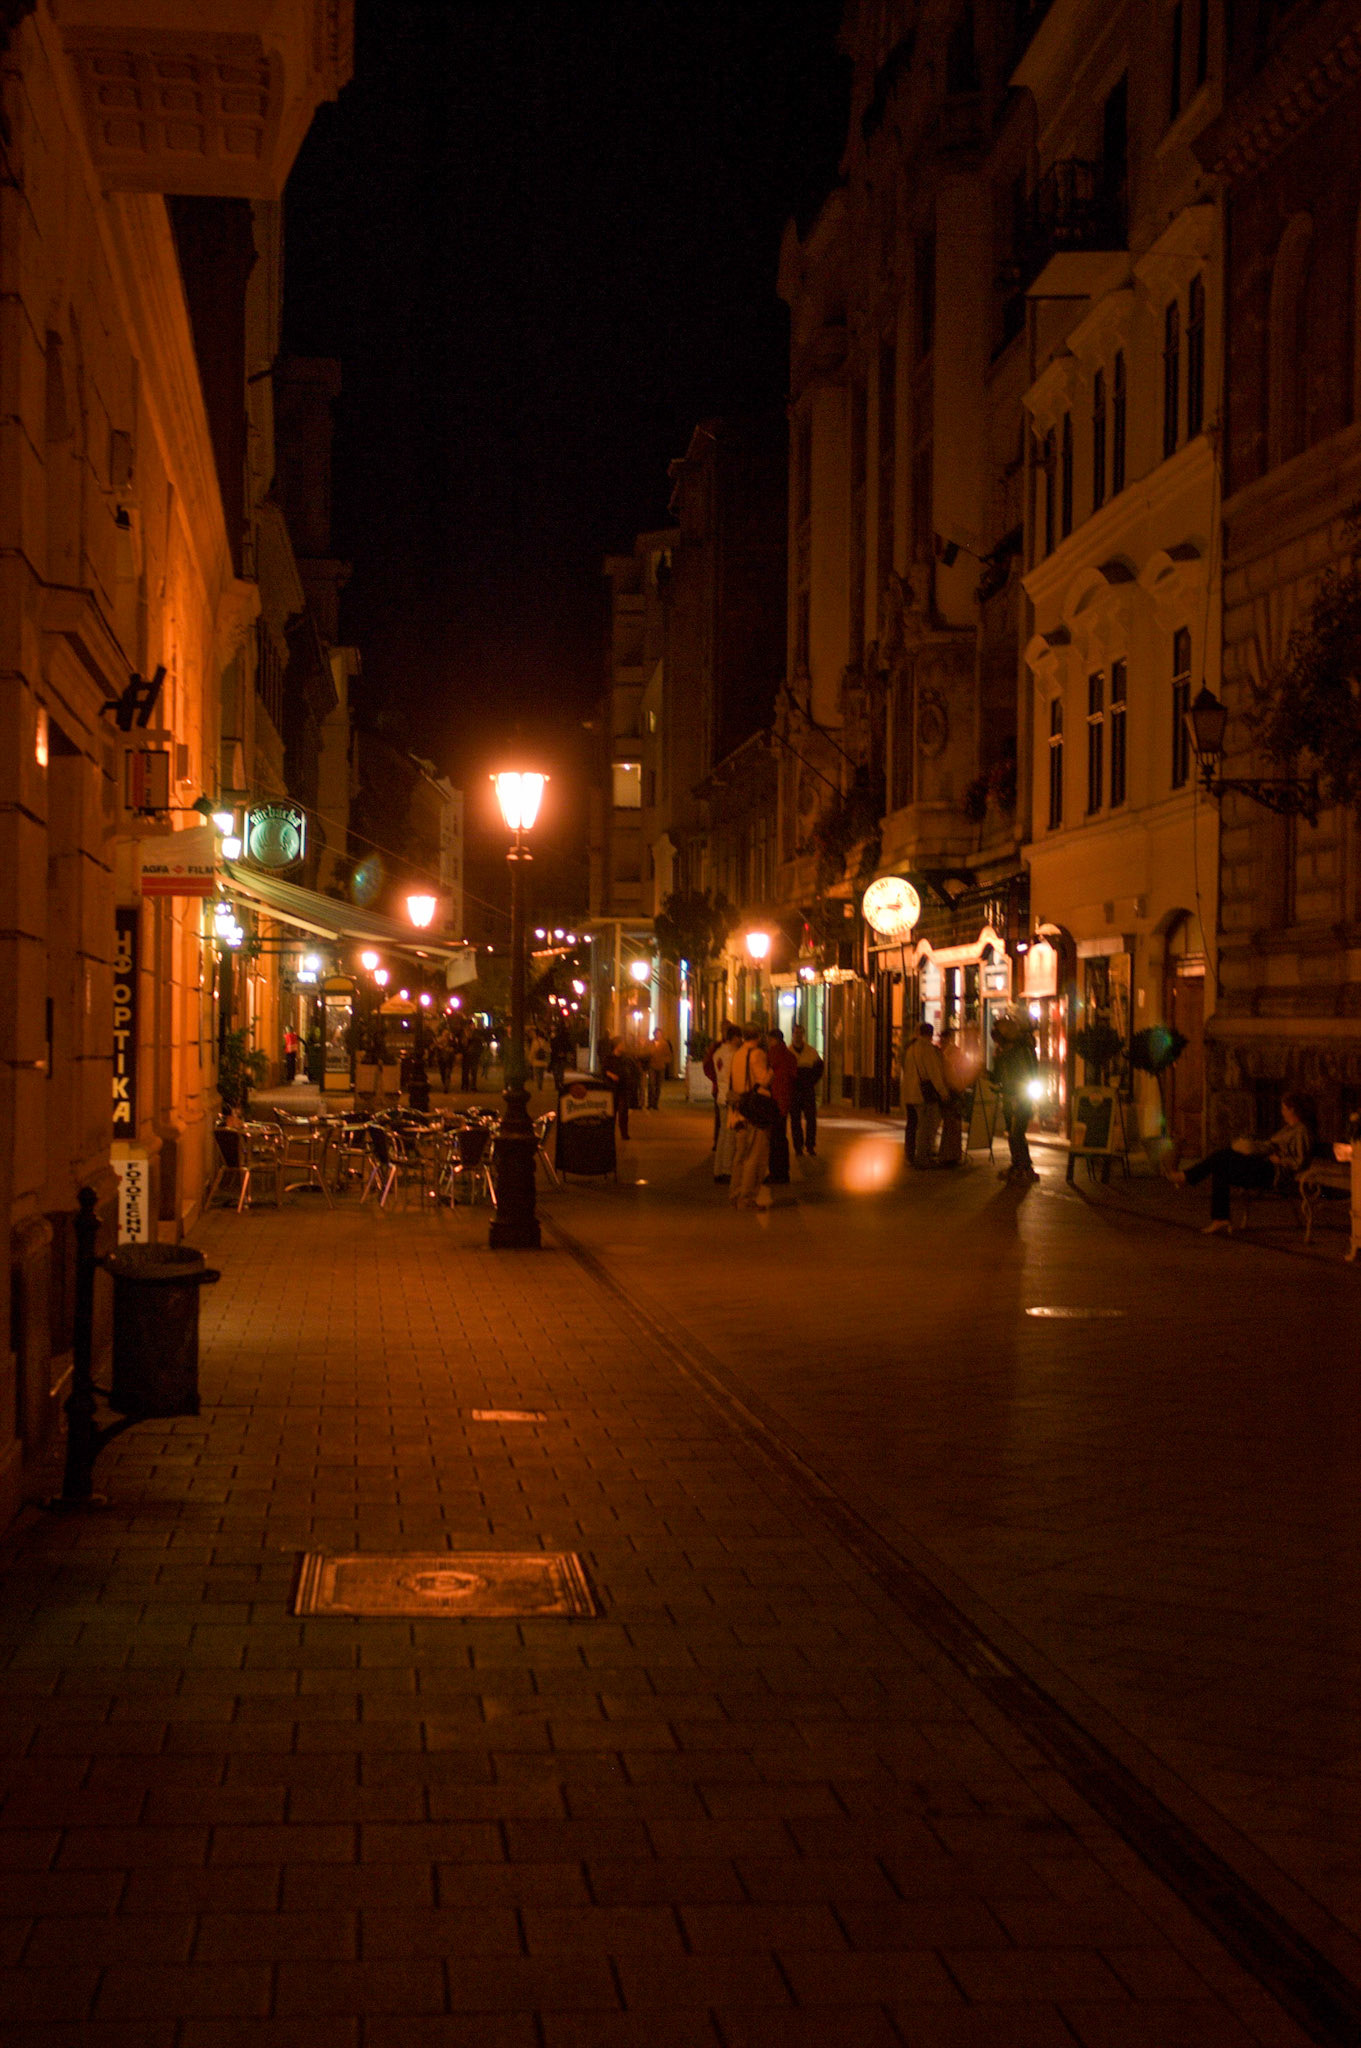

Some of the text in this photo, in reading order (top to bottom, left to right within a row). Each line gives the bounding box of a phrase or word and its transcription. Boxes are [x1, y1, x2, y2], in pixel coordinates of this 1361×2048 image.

[142, 864, 215, 874] AGFA FILM
[112, 983, 132, 1123] OPTIKA
